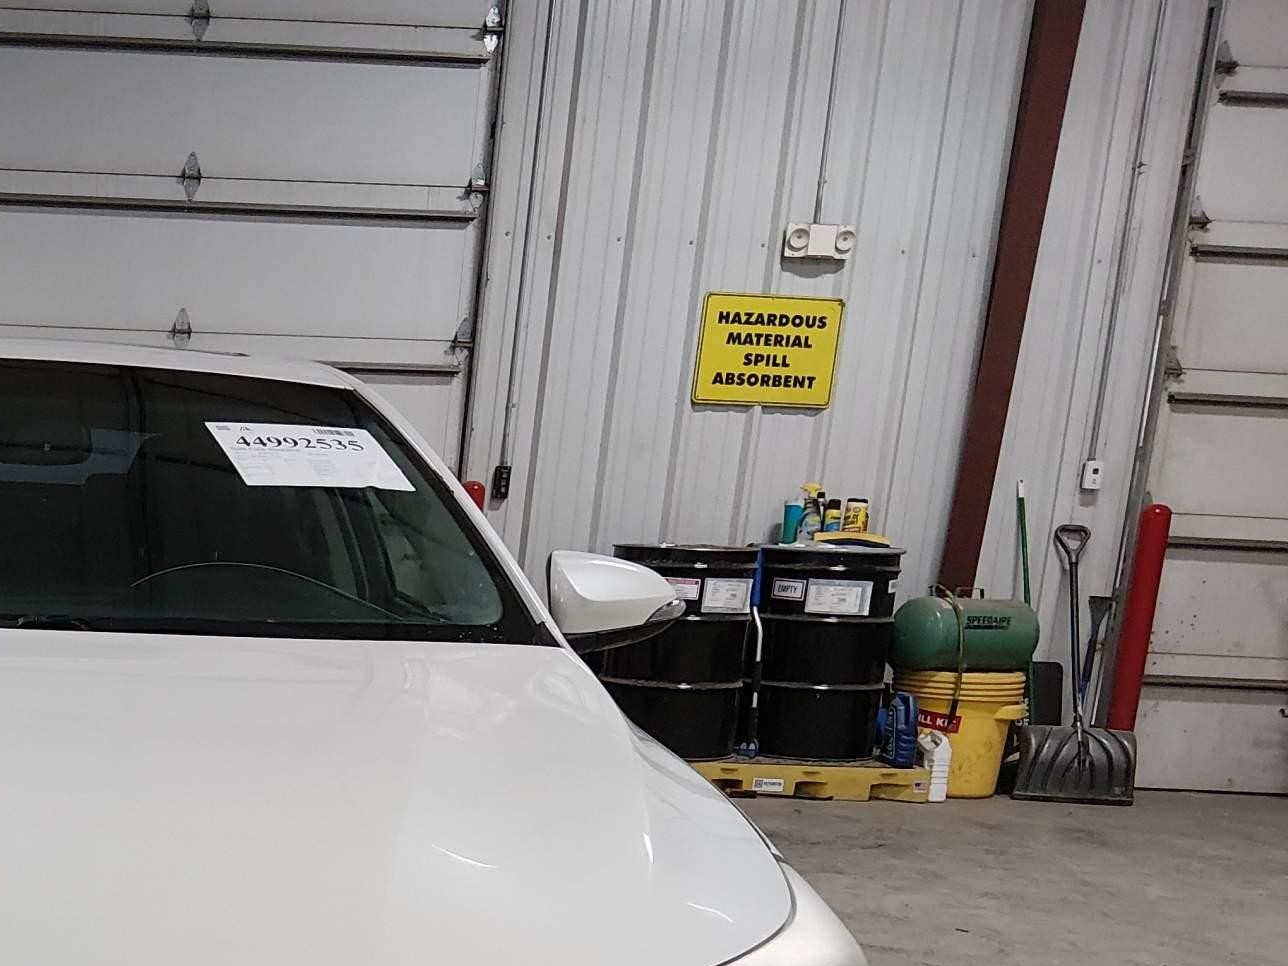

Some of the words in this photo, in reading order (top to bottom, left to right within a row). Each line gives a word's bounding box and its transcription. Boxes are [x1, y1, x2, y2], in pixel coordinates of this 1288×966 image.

[718, 311, 827, 329] HAZARDOUS
[726, 332, 812, 349] MATERIAL
[743, 353, 790, 368] SPILL
[712, 372, 816, 389] ABSORBENT
[236, 434, 364, 451] 44992535
[777, 584, 797, 593] EMPTY
[918, 713, 932, 725] ILL
